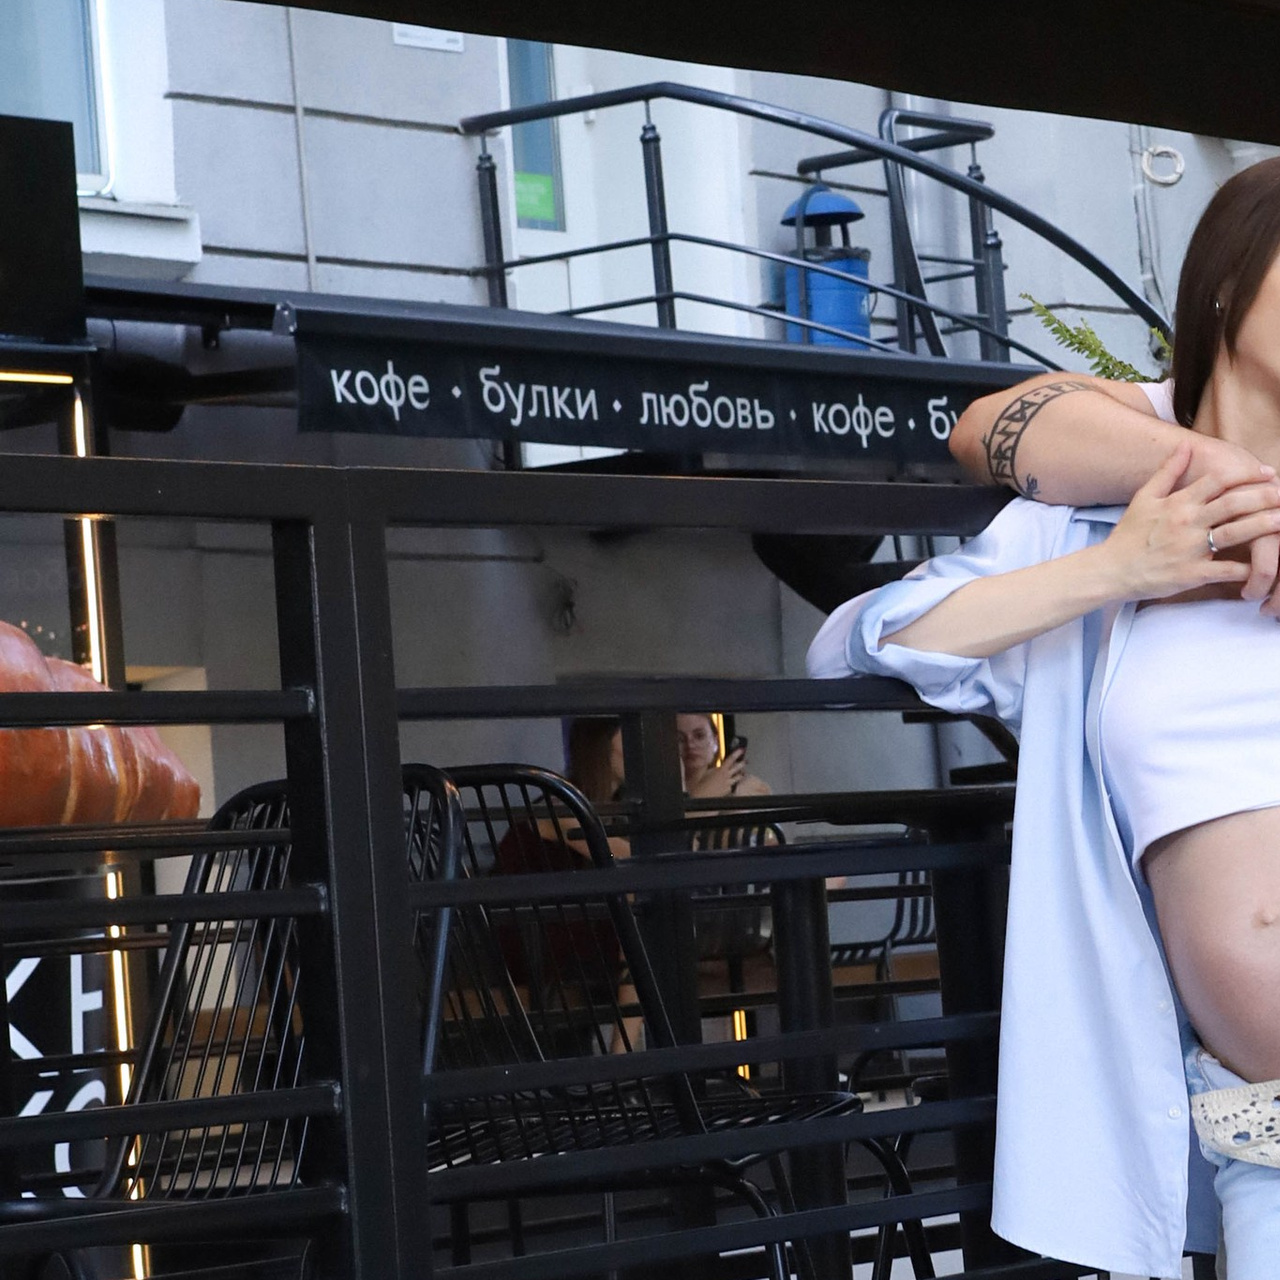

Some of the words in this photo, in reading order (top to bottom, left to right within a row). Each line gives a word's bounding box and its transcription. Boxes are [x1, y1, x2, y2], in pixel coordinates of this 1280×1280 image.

[330, 360, 430, 421] кофе
[479, 365, 599, 427] булки
[639, 380, 775, 430] любовь
[812, 393, 895, 449] кофе
[927, 395, 959, 441] б
